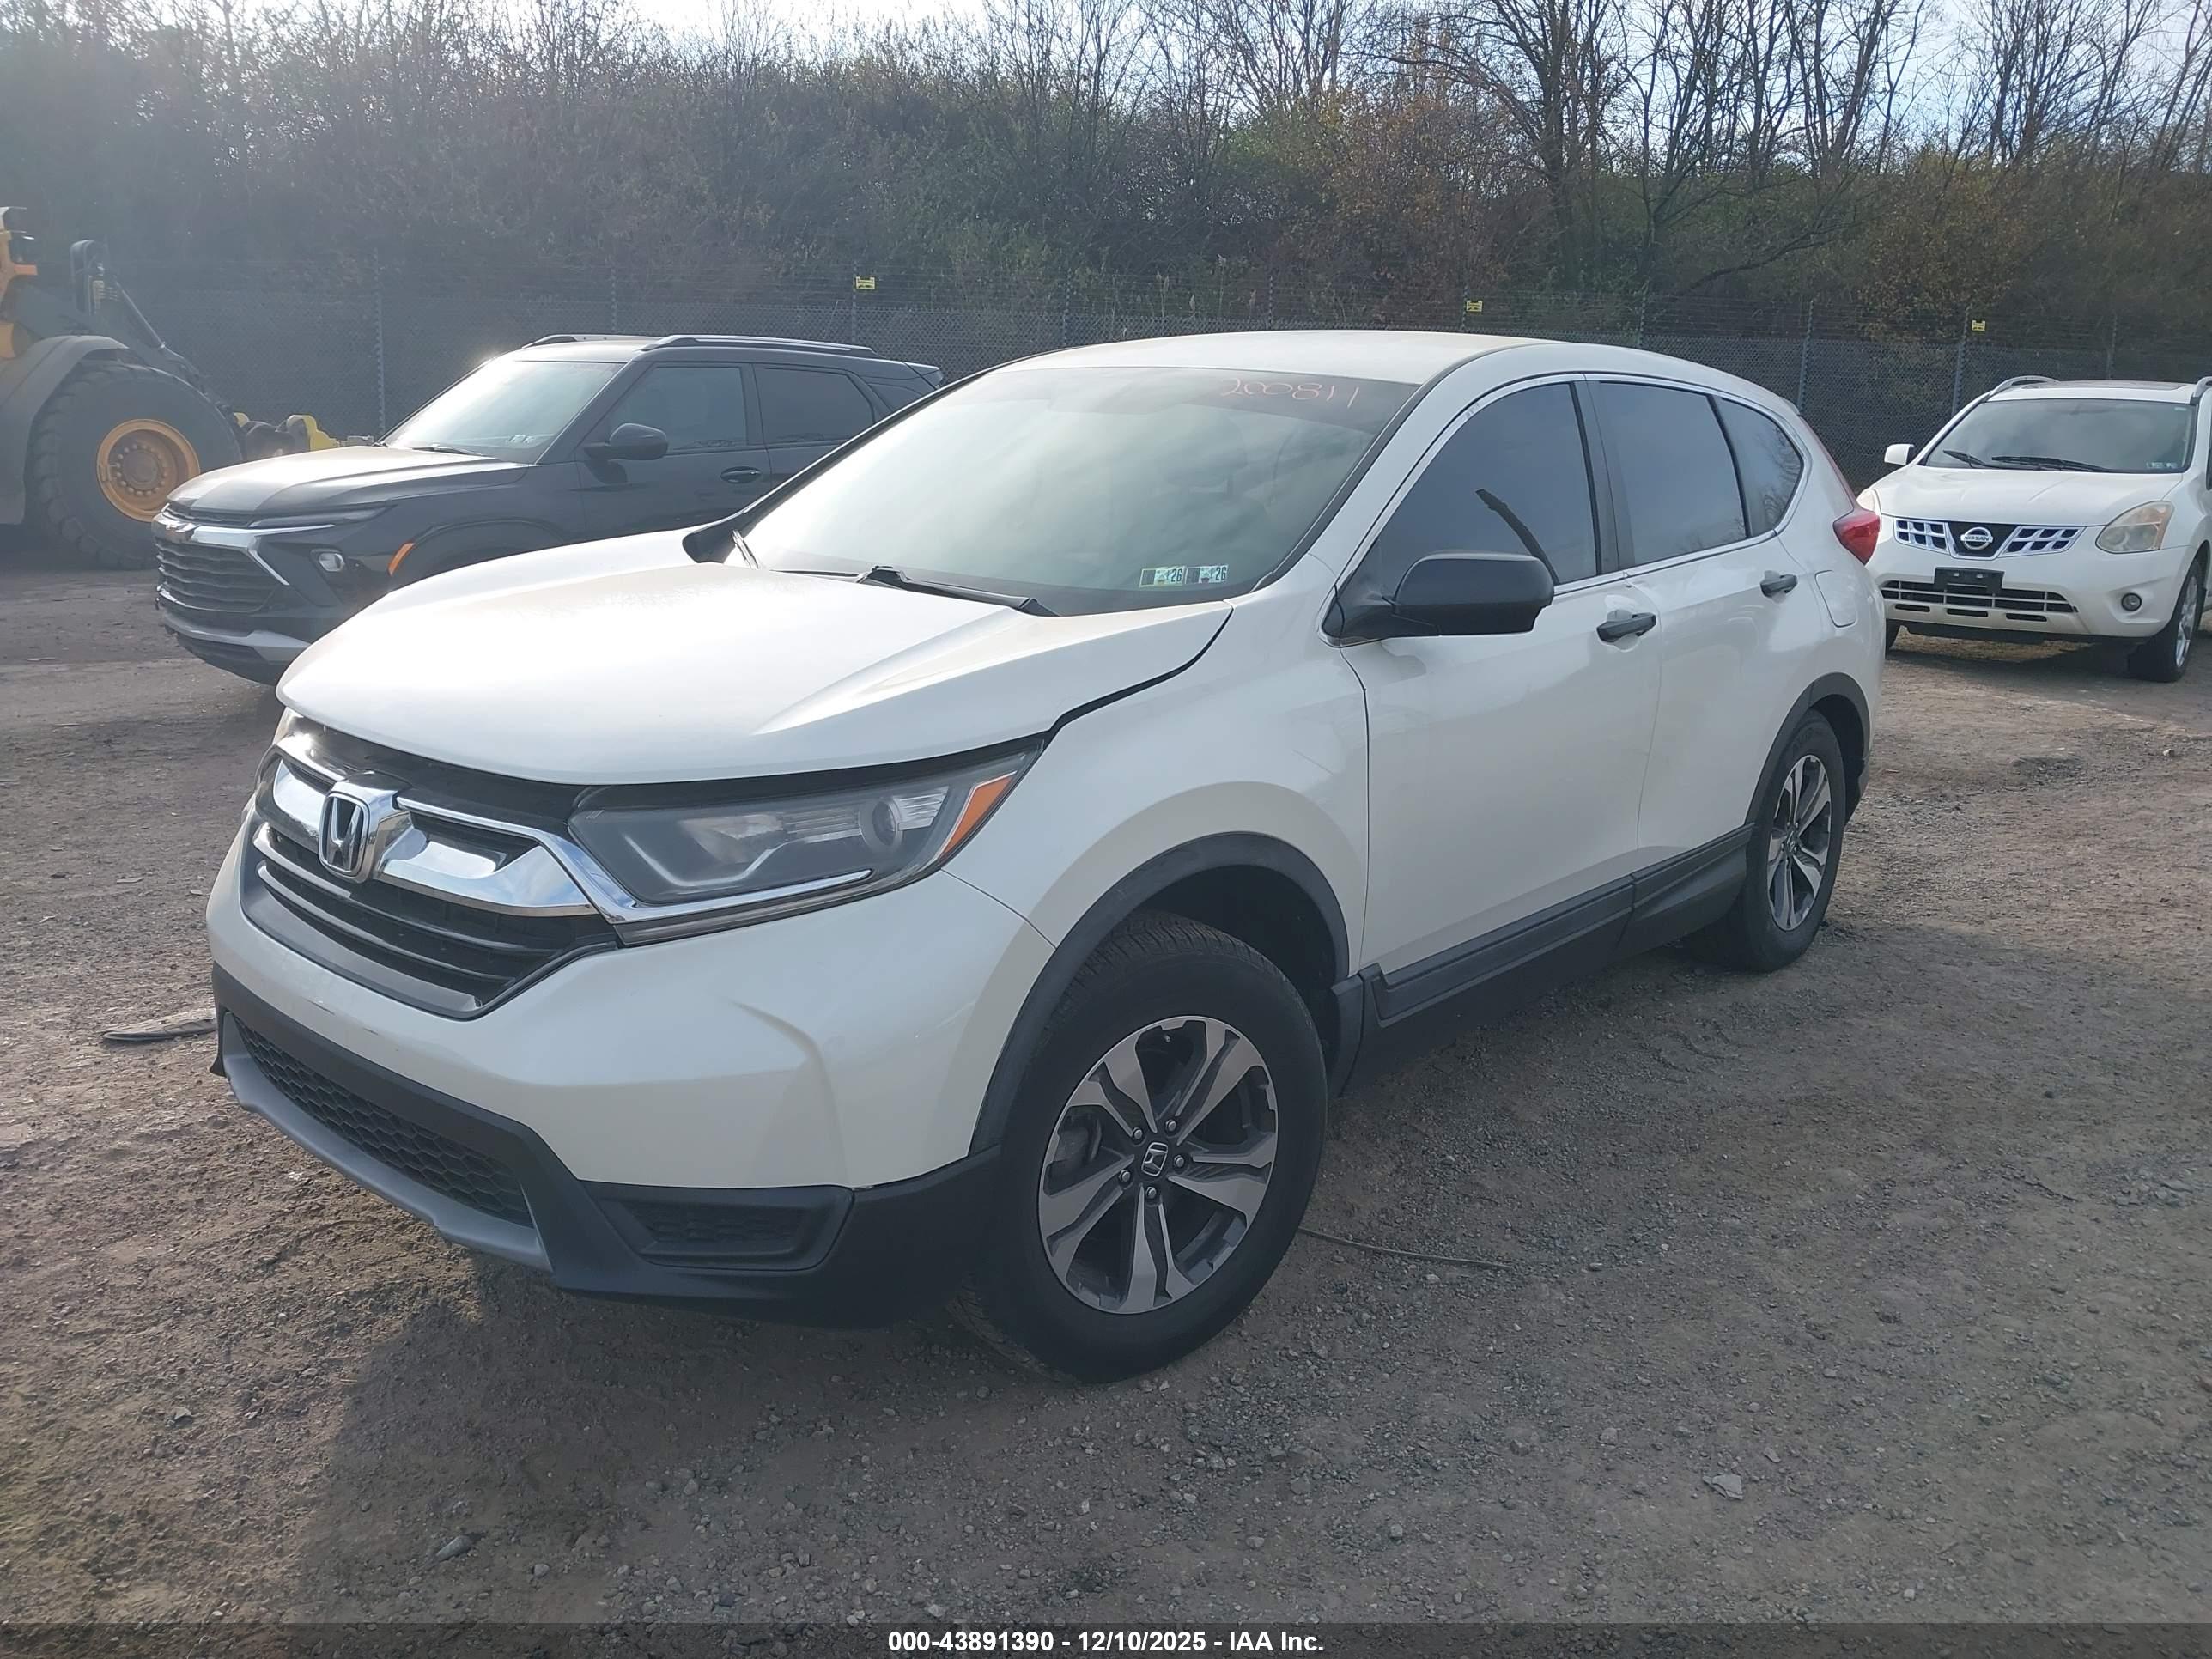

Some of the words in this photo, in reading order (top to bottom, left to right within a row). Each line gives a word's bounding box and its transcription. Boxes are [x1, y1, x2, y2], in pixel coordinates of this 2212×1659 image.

[1220, 378, 1360, 408] 200811
[1170, 568, 1182, 583] 26
[1215, 567, 1227, 581] 26
